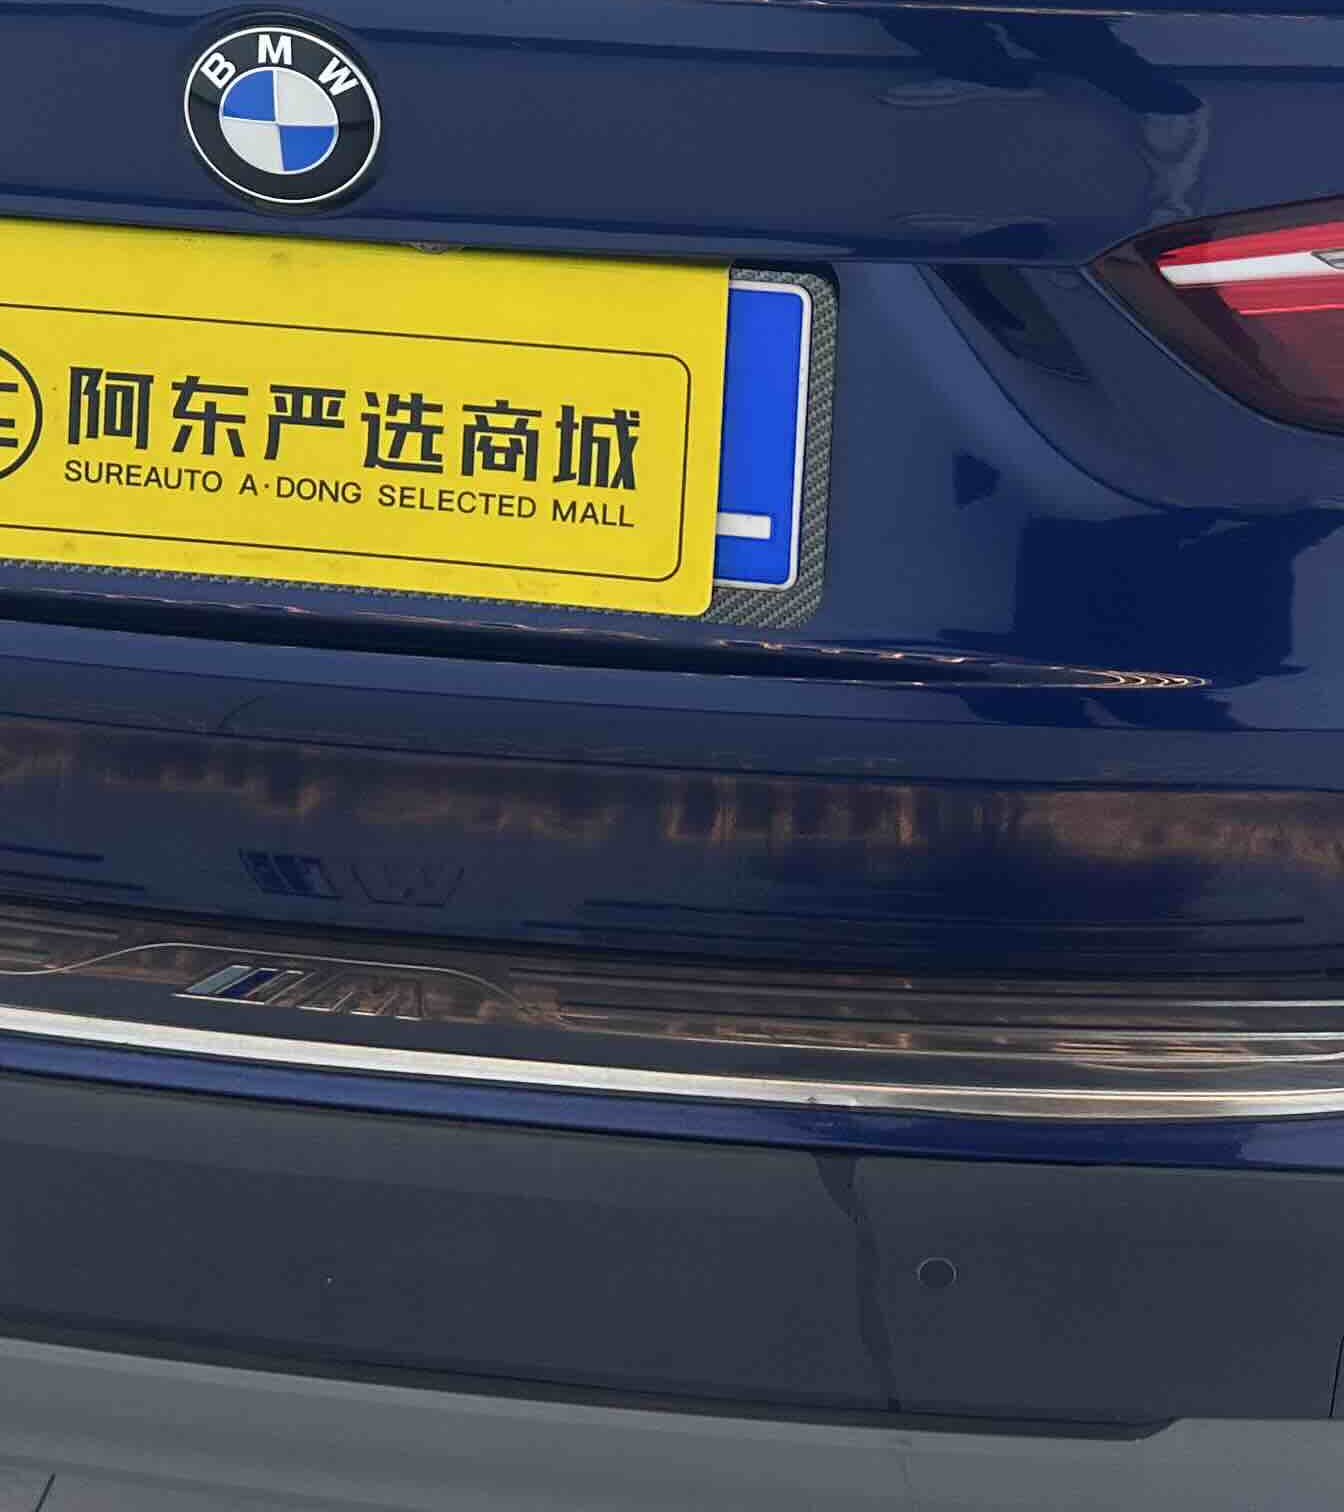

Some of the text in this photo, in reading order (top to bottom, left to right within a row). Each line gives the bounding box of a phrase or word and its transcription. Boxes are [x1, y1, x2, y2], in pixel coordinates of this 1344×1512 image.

[199, 33, 360, 97] BMW
[67, 365, 641, 490] 阿东严选商城
[63, 459, 223, 493] SUREAUTO
[377, 486, 537, 519] SELECTED
[551, 499, 635, 528] MALL
